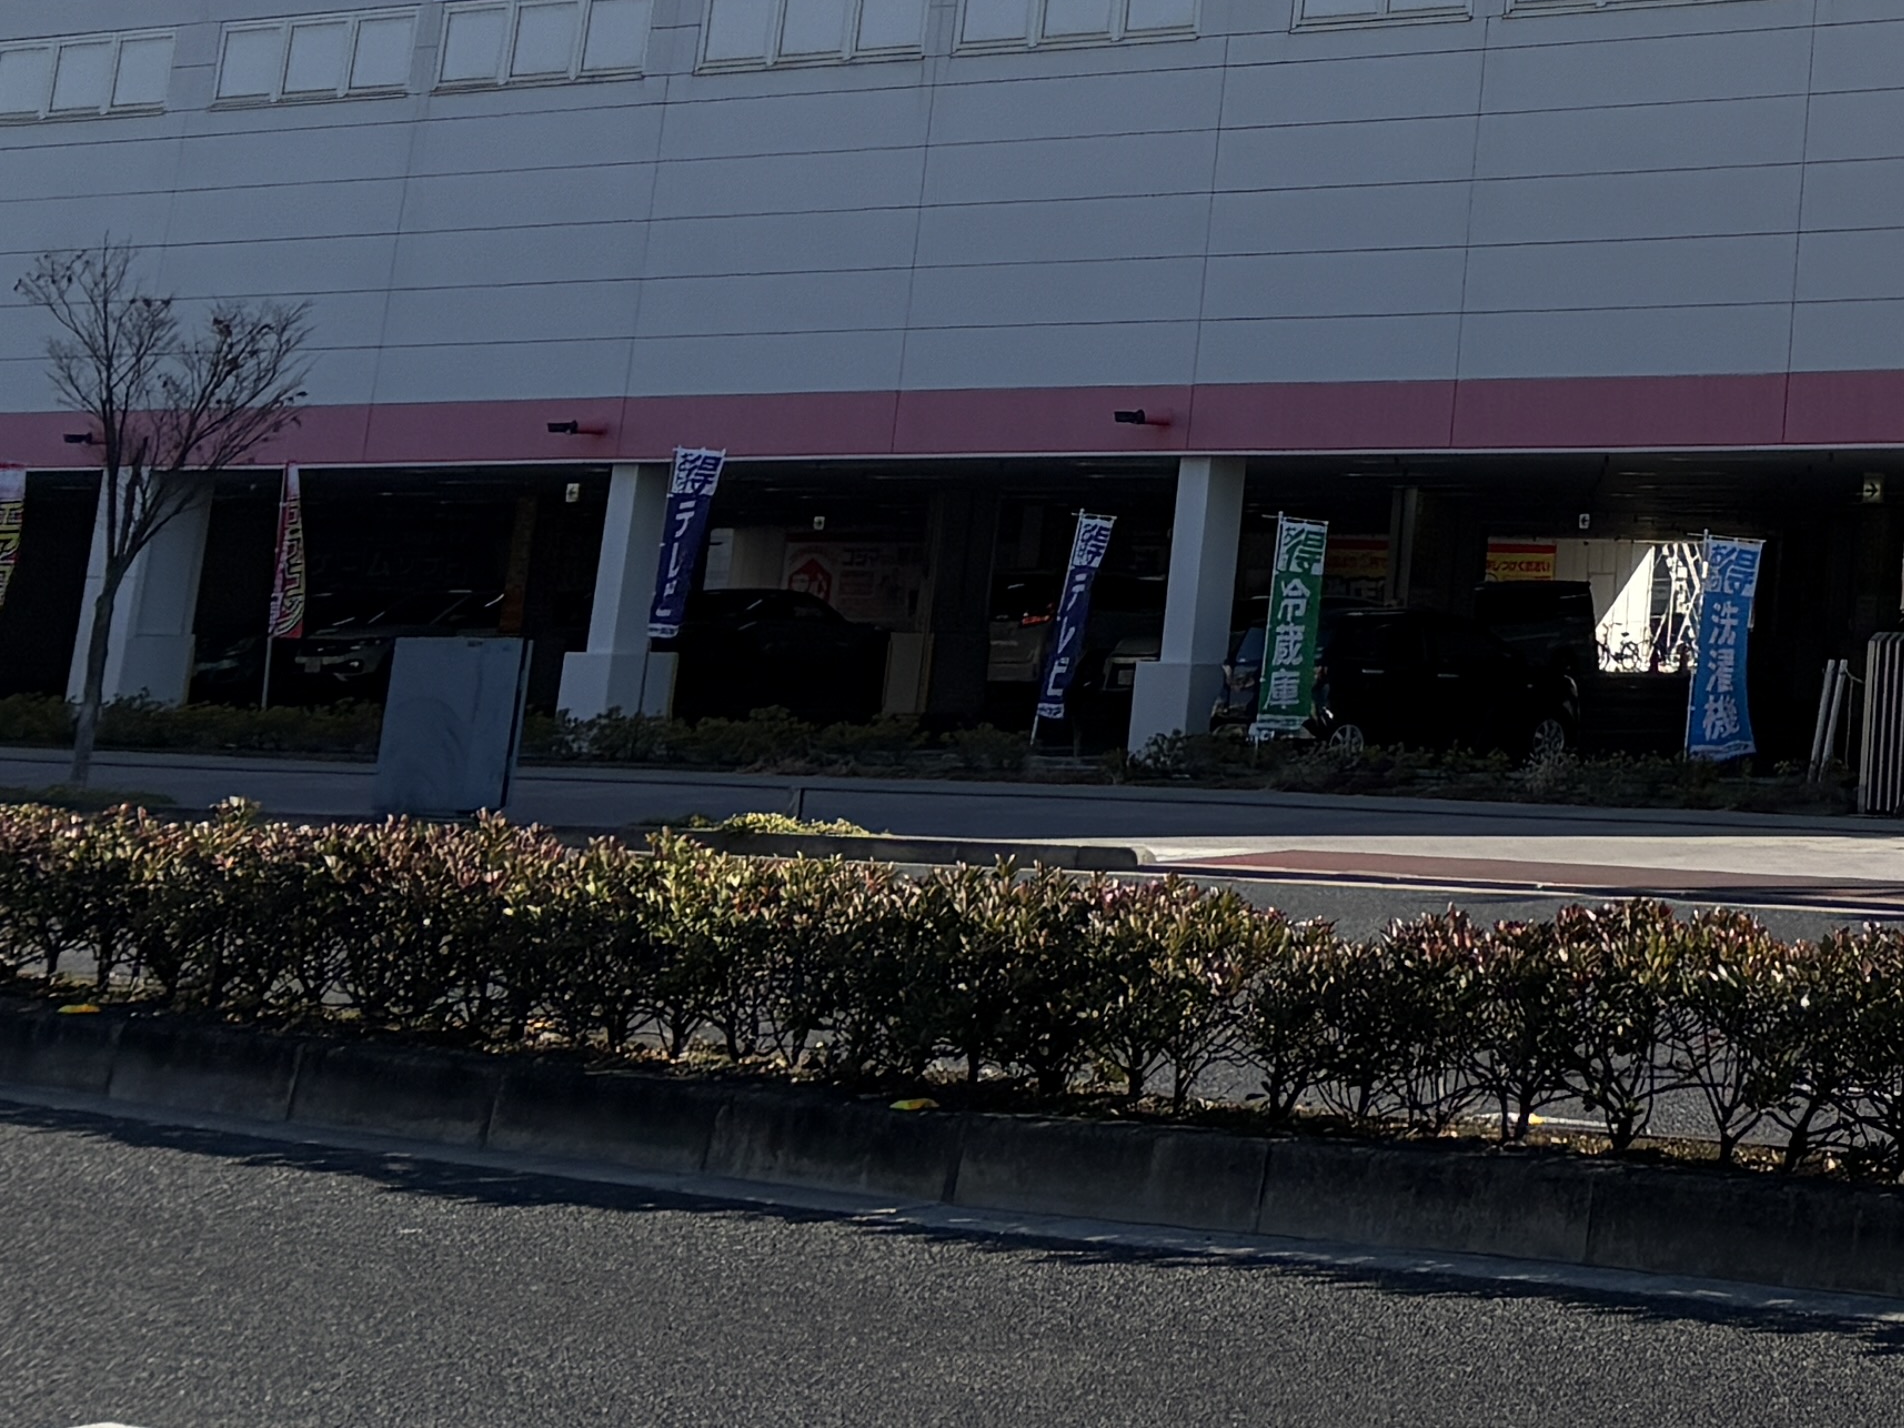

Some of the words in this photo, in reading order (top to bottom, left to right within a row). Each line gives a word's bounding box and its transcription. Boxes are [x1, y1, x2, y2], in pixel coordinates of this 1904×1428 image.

[1268, 577, 1311, 711] 冷蔵庫
[1702, 600, 1741, 742] 洗濯機
